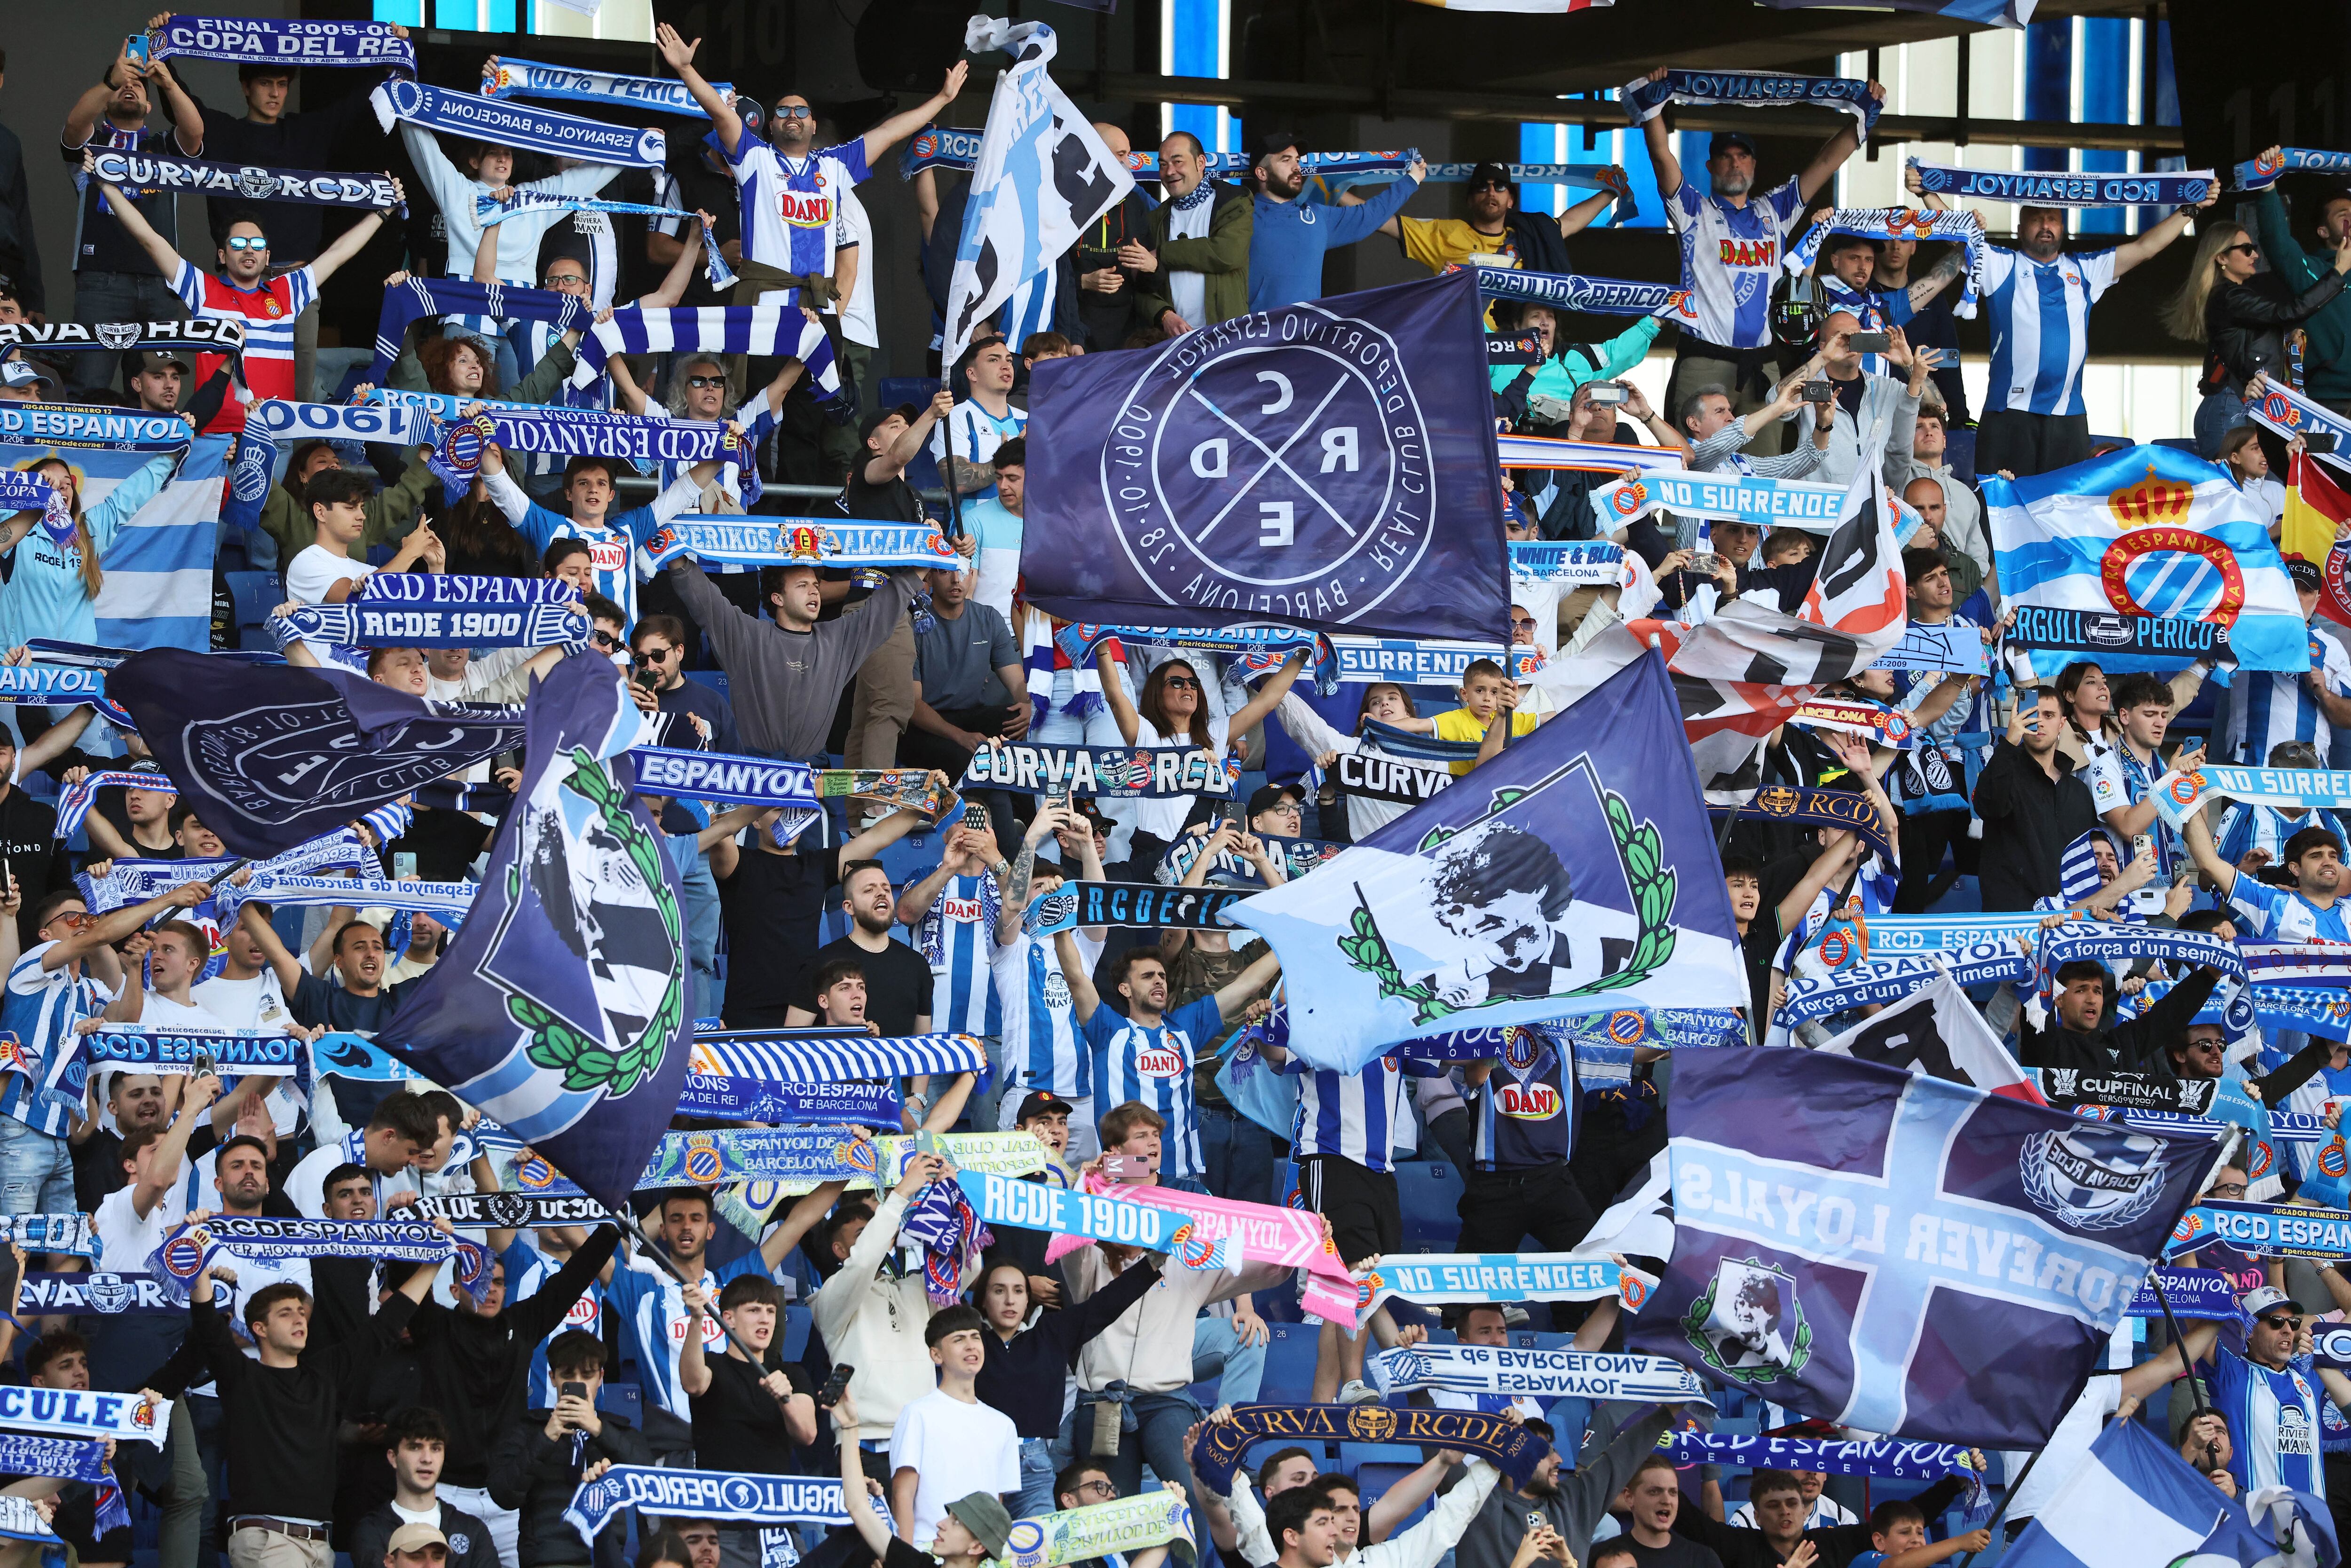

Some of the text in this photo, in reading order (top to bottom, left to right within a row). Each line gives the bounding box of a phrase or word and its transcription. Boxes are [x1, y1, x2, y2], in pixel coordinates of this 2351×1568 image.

[198, 19, 279, 32] FINAL
[172, 28, 415, 60] COPA DEL REY
[525, 67, 592, 90] 100%
[943, 135, 980, 157] RCD
[95, 153, 397, 205] CURVA RCDE
[781, 194, 829, 221] DANI
[576, 215, 602, 225] RIVIERA
[576, 222, 605, 234] MAYA
[1719, 240, 1775, 266] DANI
[1478, 274, 1667, 307] ORGULLO PERICO
[64, 405, 101, 414] NÚMERO
[382, 388, 446, 416] RCD
[32, 413, 184, 439] ESPANYOL
[260, 401, 407, 436] 1900
[543, 410, 670, 426] De BARCELONA
[34, 437, 105, 449] #pericodecarnet
[501, 418, 719, 460] RCD ESPANYOL
[1659, 481, 1846, 517] NO SURRENDE
[673, 525, 926, 555] PERIKOS ALCALA
[35, 552, 61, 567] RCDE
[1516, 547, 1623, 564] WHITE & BLUE
[2105, 532, 2233, 580] RCD ESPANYOL
[2288, 564, 2316, 577] RCDE
[364, 573, 425, 602] RCD
[212, 609, 229, 619] NIKE
[364, 613, 522, 637] RCDE 1900
[2137, 616, 2214, 651] PERICO
[212, 633, 225, 643] nike
[1177, 640, 1238, 649] #pericodecarnet
[640, 755, 814, 797] ESPANYOL
[968, 749, 1231, 794] CURVA RCD
[2217, 771, 2251, 791] NO
[944, 898, 982, 919] DANI
[1088, 887, 1182, 923] RCDE
[1879, 930, 1924, 948] RCD
[2052, 942, 2071, 961] La
[2075, 940, 2123, 956] força
[2130, 937, 2164, 956] d'un
[1838, 943, 2016, 984] ESPANYOL
[1797, 982, 1892, 1019] força d'un
[2254, 1001, 2310, 1015] BARCELONA
[1654, 1009, 1737, 1030] ESPANYOL
[1141, 1056, 1176, 1072] DANI
[698, 1092, 739, 1106] DEL REI
[2082, 1078, 2172, 1102] CUPFINAL
[2217, 1093, 2232, 1102] RCD
[799, 1099, 878, 1111] DE BARCELONA
[1505, 1088, 1554, 1115] DANI
[729, 1136, 836, 1152] ESPANYOL DE
[744, 1156, 836, 1170] BARCELONA
[1107, 1158, 1124, 1173] M
[984, 1175, 1160, 1246] RCDE 1900
[2272, 1207, 2307, 1218] JUGADOR
[2309, 1210, 2340, 1219] NÚMERO
[212, 1221, 446, 1243] RCDESPANYOL
[2214, 1213, 2271, 1240] RCD
[304, 1242, 374, 1257] MAÑANA
[379, 1247, 388, 1257] Y
[393, 1246, 451, 1261] SIEMPRE
[2282, 1247, 2344, 1258] #pericodecarnet
[1395, 1265, 1607, 1292] NO SURRENDER
[94, 1286, 112, 1295] CURVA
[1276, 1329, 1287, 1339] 26
[1521, 1338, 1531, 1346] 23
[626, 1391, 636, 1400] 14
[1213, 1406, 1518, 1451] CURVA RCDE
[2278, 1428, 2309, 1440] RIVIERA
[1205, 1443, 1228, 1467] 2002
[1507, 1432, 1528, 1458] 2022
[1768, 1438, 1956, 1467] ESPANYOL
[2277, 1438, 2312, 1454] MAYA
